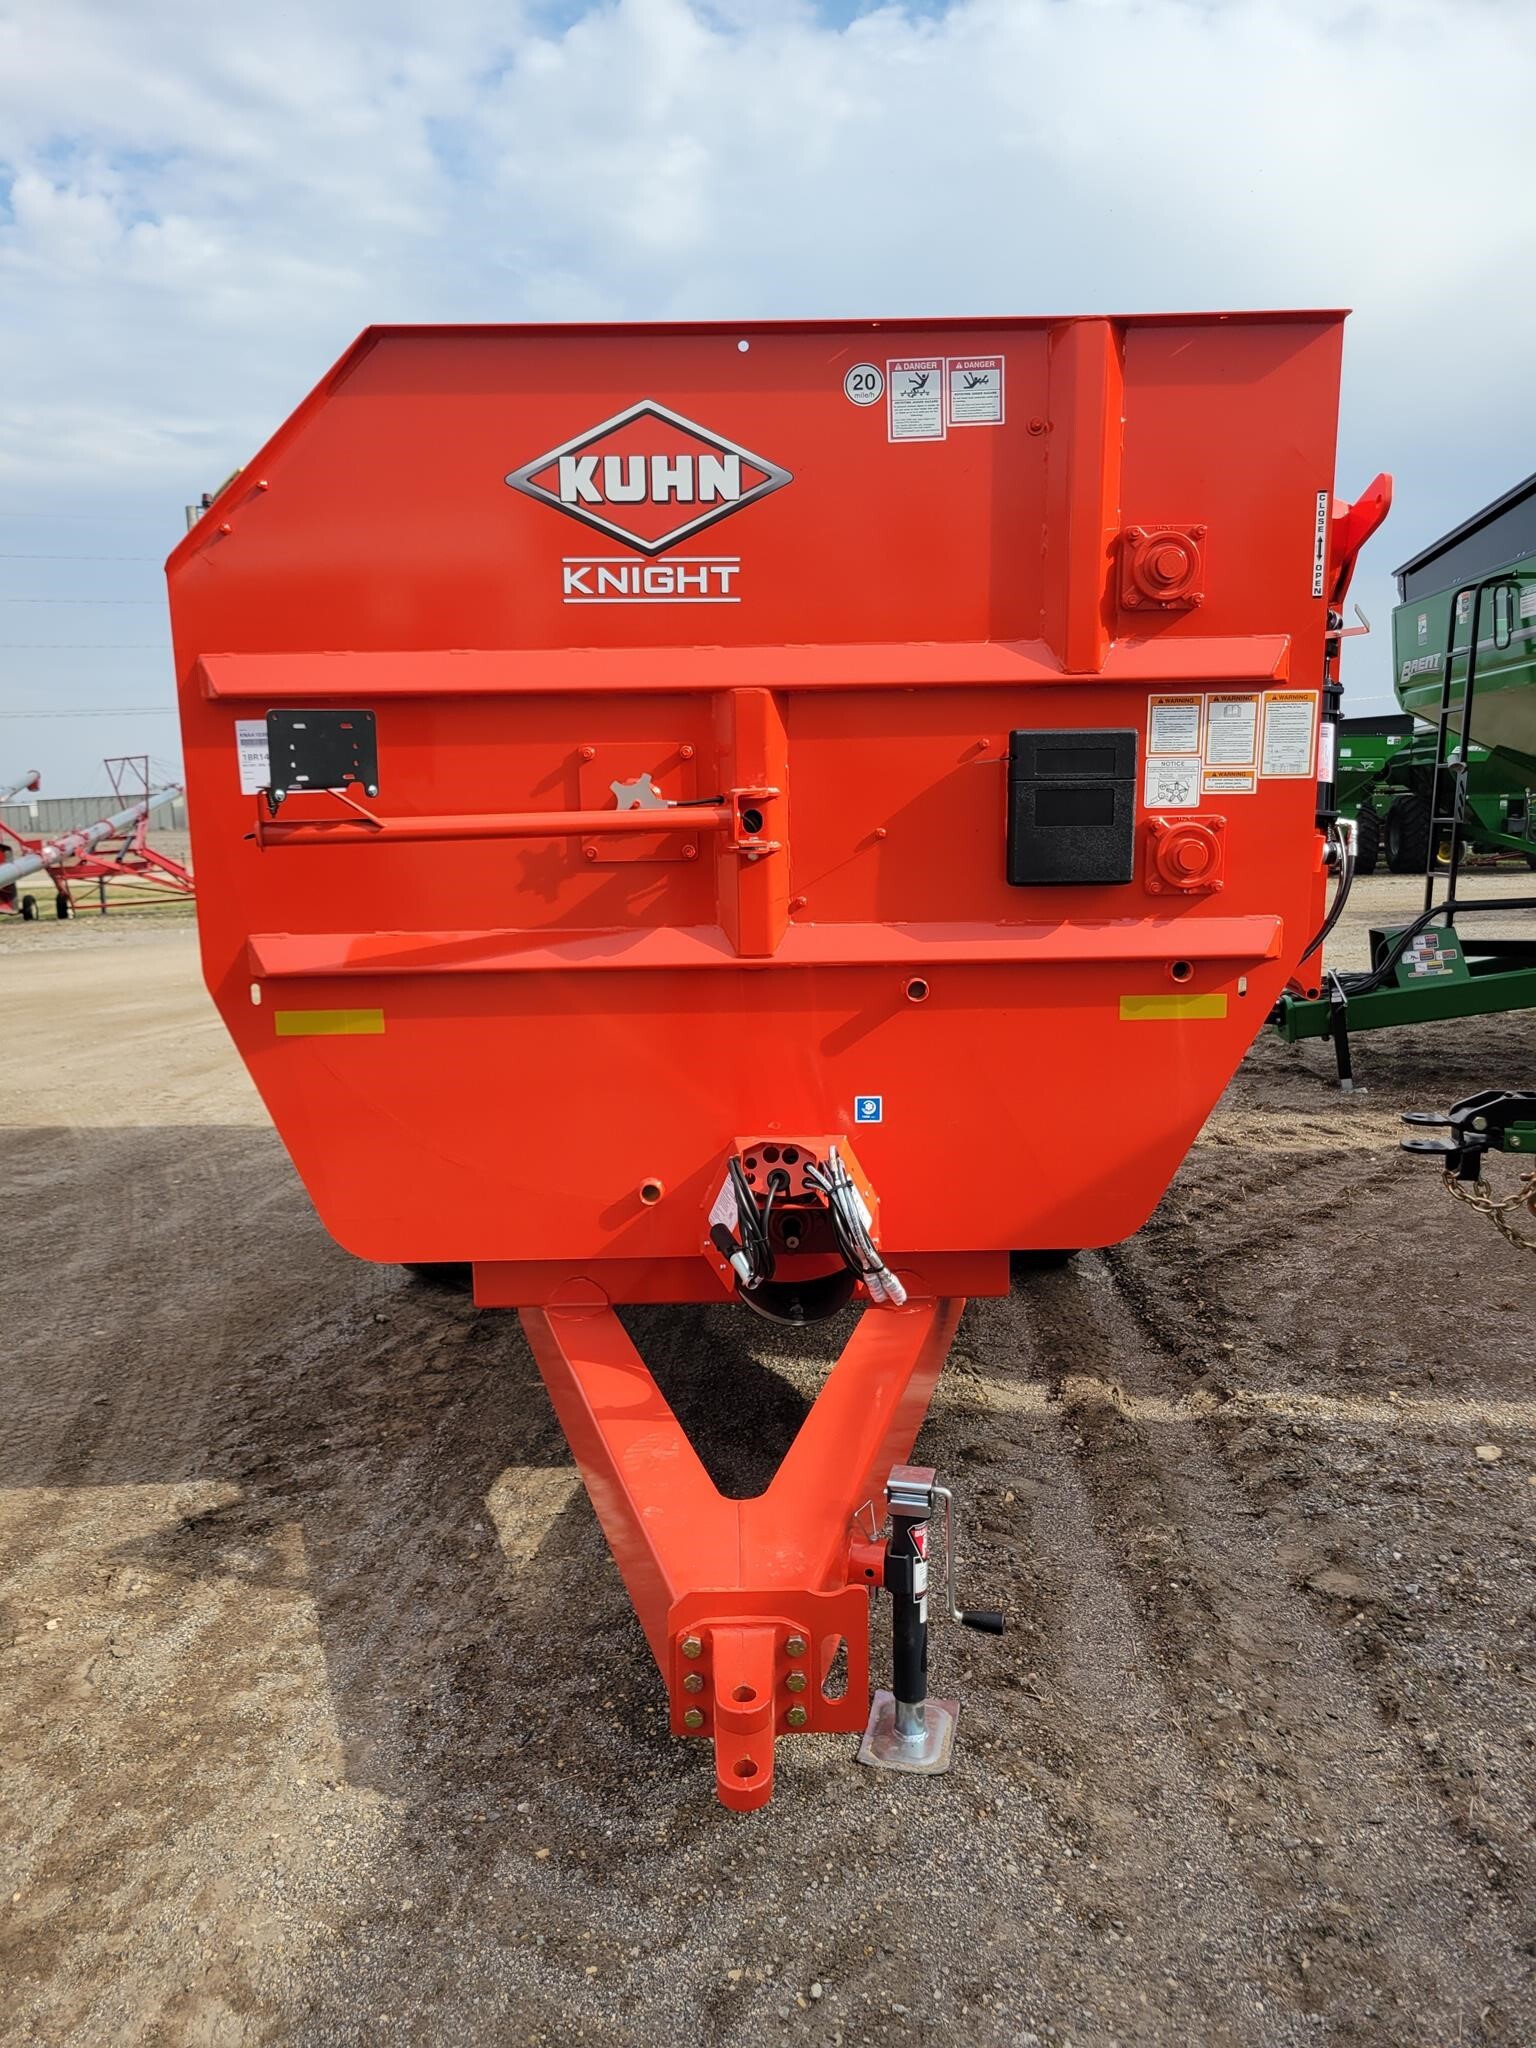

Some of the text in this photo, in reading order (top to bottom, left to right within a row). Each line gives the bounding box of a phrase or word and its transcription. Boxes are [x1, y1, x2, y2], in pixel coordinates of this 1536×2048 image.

[903, 361, 937, 370] DANGER
[964, 360, 995, 369] DANGER
[853, 374, 876, 390] 20
[558, 455, 741, 503] KUHN
[1317, 494, 1326, 533] CLOSE
[563, 566, 740, 594] KNIGHT
[1313, 564, 1323, 595] OPEN
[1401, 653, 1442, 683] BRENT
